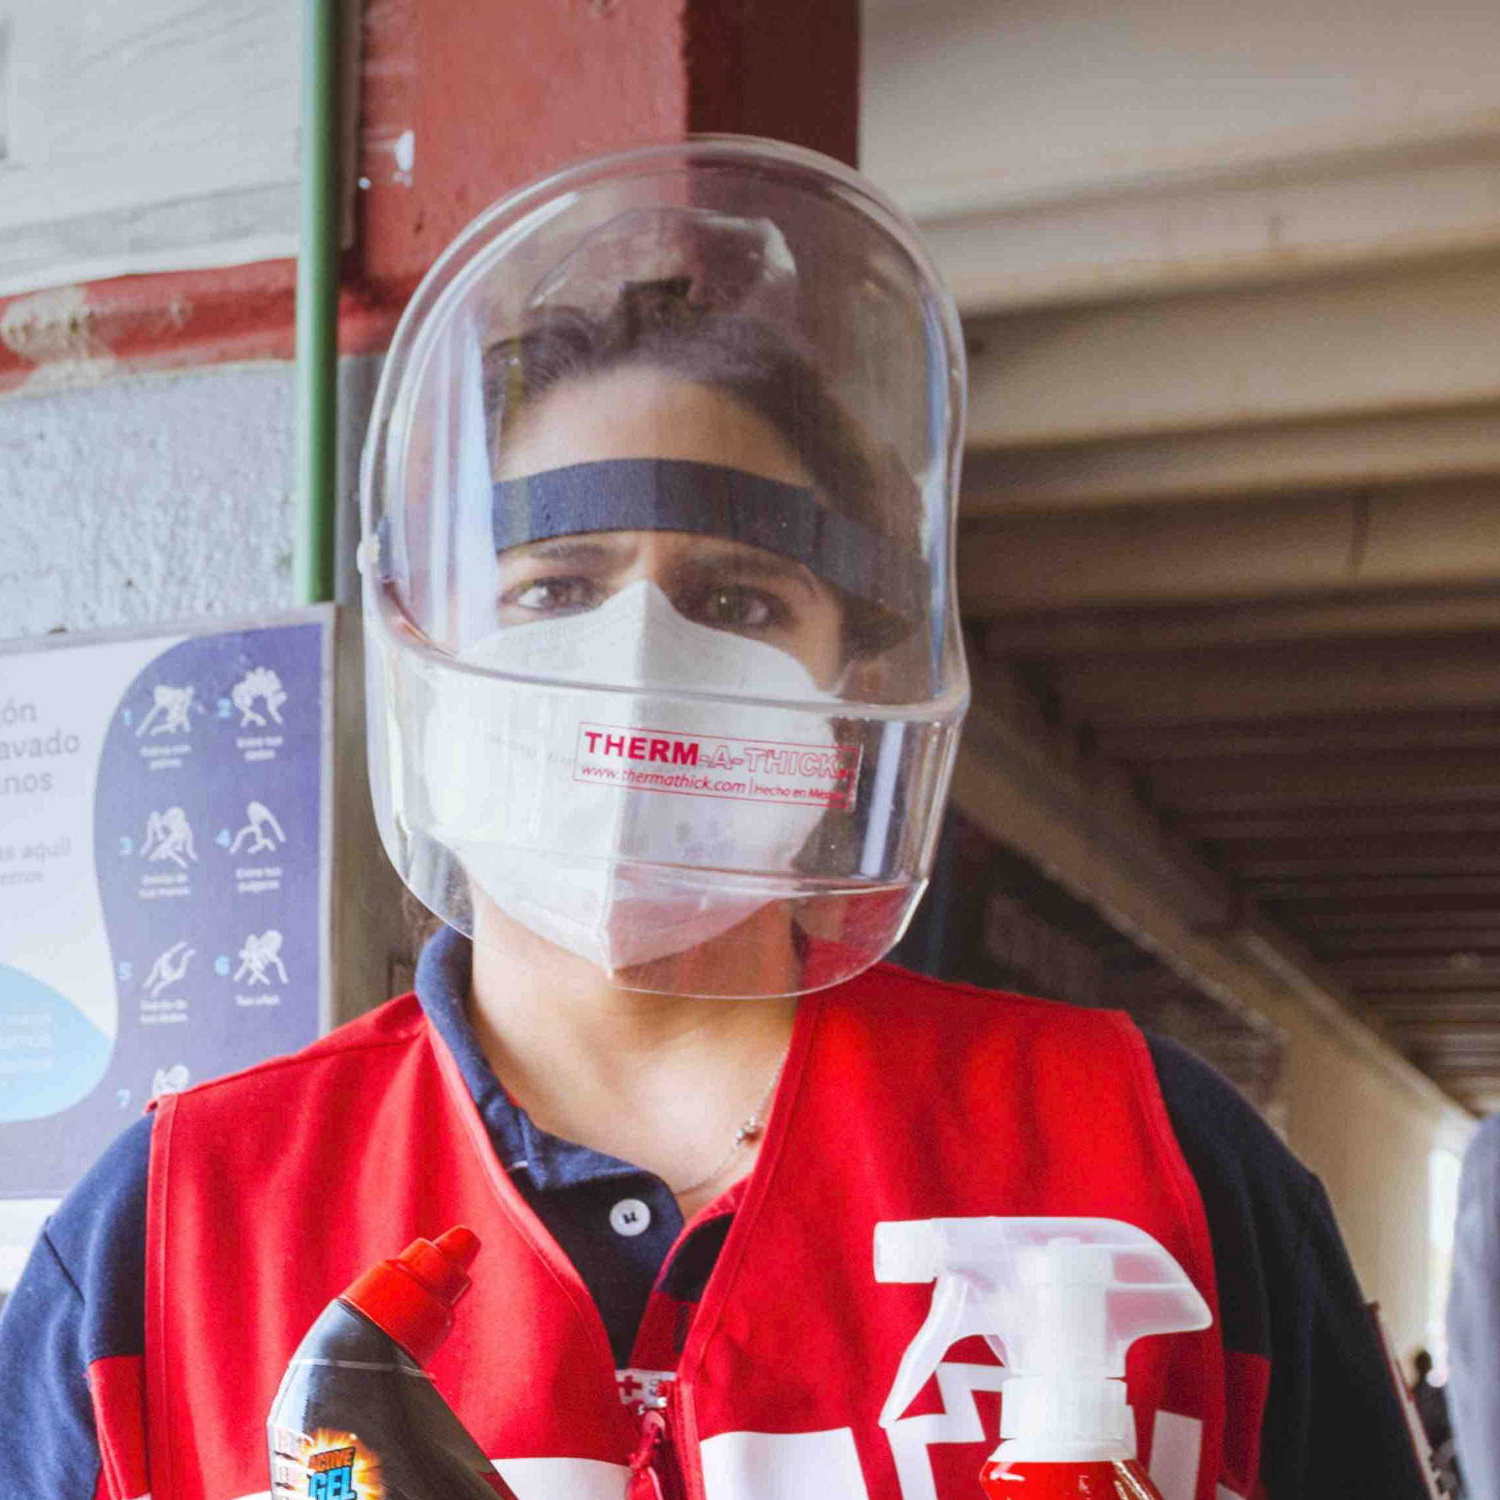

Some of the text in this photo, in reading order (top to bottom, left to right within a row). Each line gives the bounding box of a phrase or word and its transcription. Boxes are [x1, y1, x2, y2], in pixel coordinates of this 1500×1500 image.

[217, 698, 232, 718] 2
[582, 764, 747, 794] www.thermathick.com
[215, 829, 231, 848] 4
[118, 954, 230, 980] 5 6
